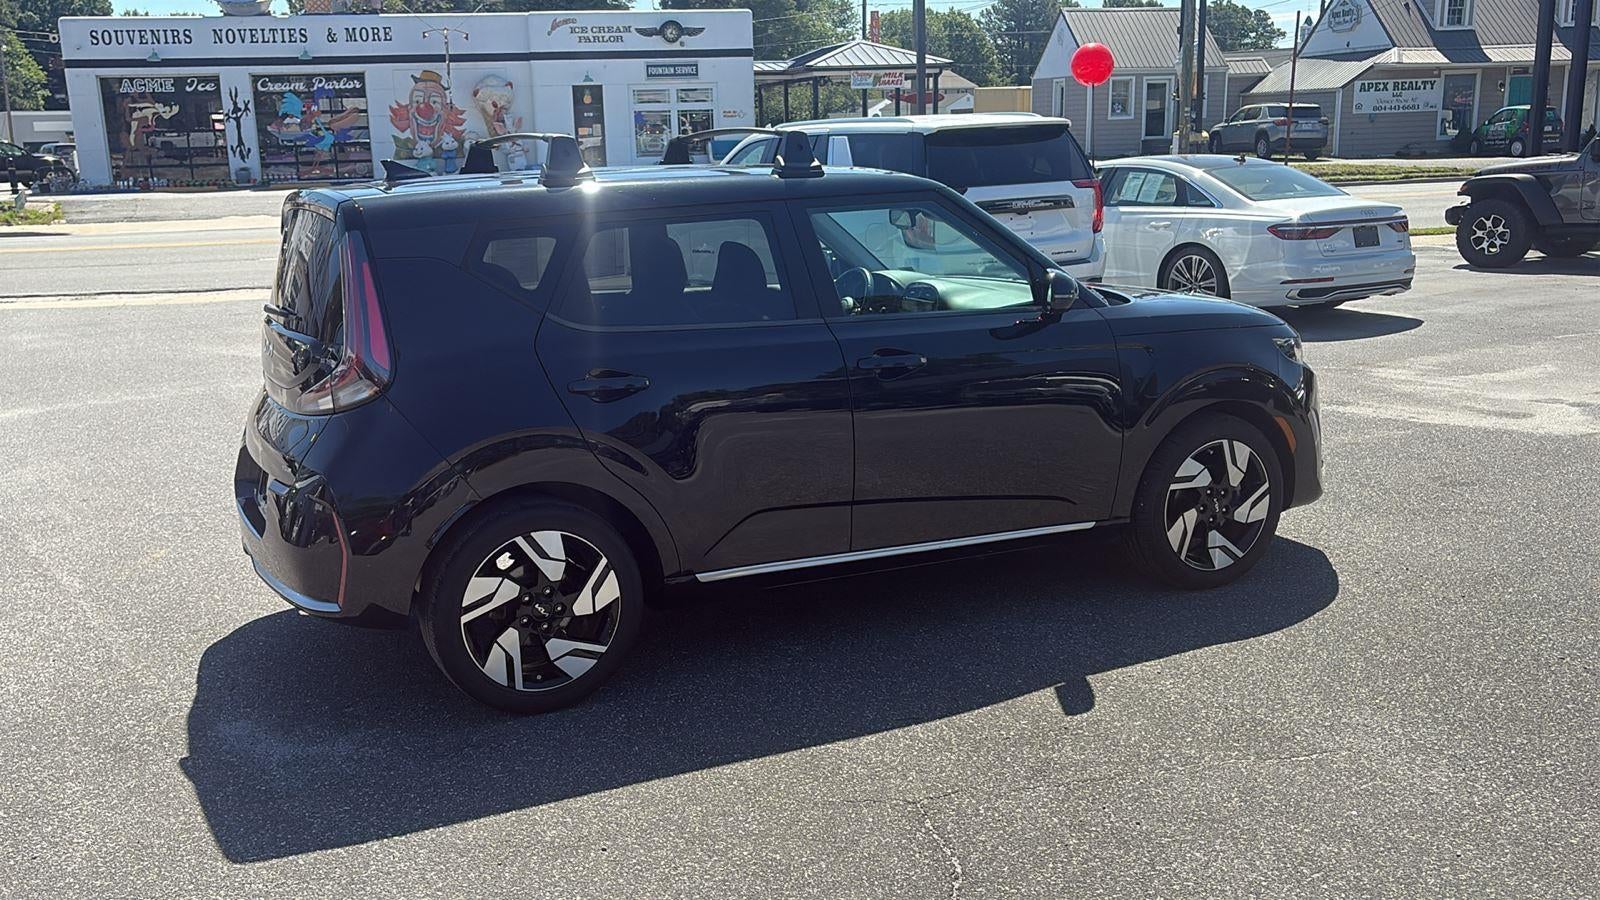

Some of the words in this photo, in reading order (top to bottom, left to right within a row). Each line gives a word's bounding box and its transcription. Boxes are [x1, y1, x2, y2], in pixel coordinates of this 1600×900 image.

[570, 25, 588, 34] ICE
[590, 25, 632, 34] CREAM
[90, 28, 193, 46] SOUVENIRS
[212, 26, 308, 45] NOVELTIES
[326, 27, 338, 43] &
[344, 26, 393, 43] MORE
[577, 35, 624, 44] PARLOR
[648, 66, 674, 75] FOUNTAIN
[675, 65, 697, 74] SERVICE
[119, 78, 175, 93] ACME
[185, 77, 217, 92] Ice
[257, 77, 307, 92] Cream
[310, 76, 363, 92] Parlor
[1358, 82, 1390, 93] APEX
[1392, 80, 1437, 91] REALTY
